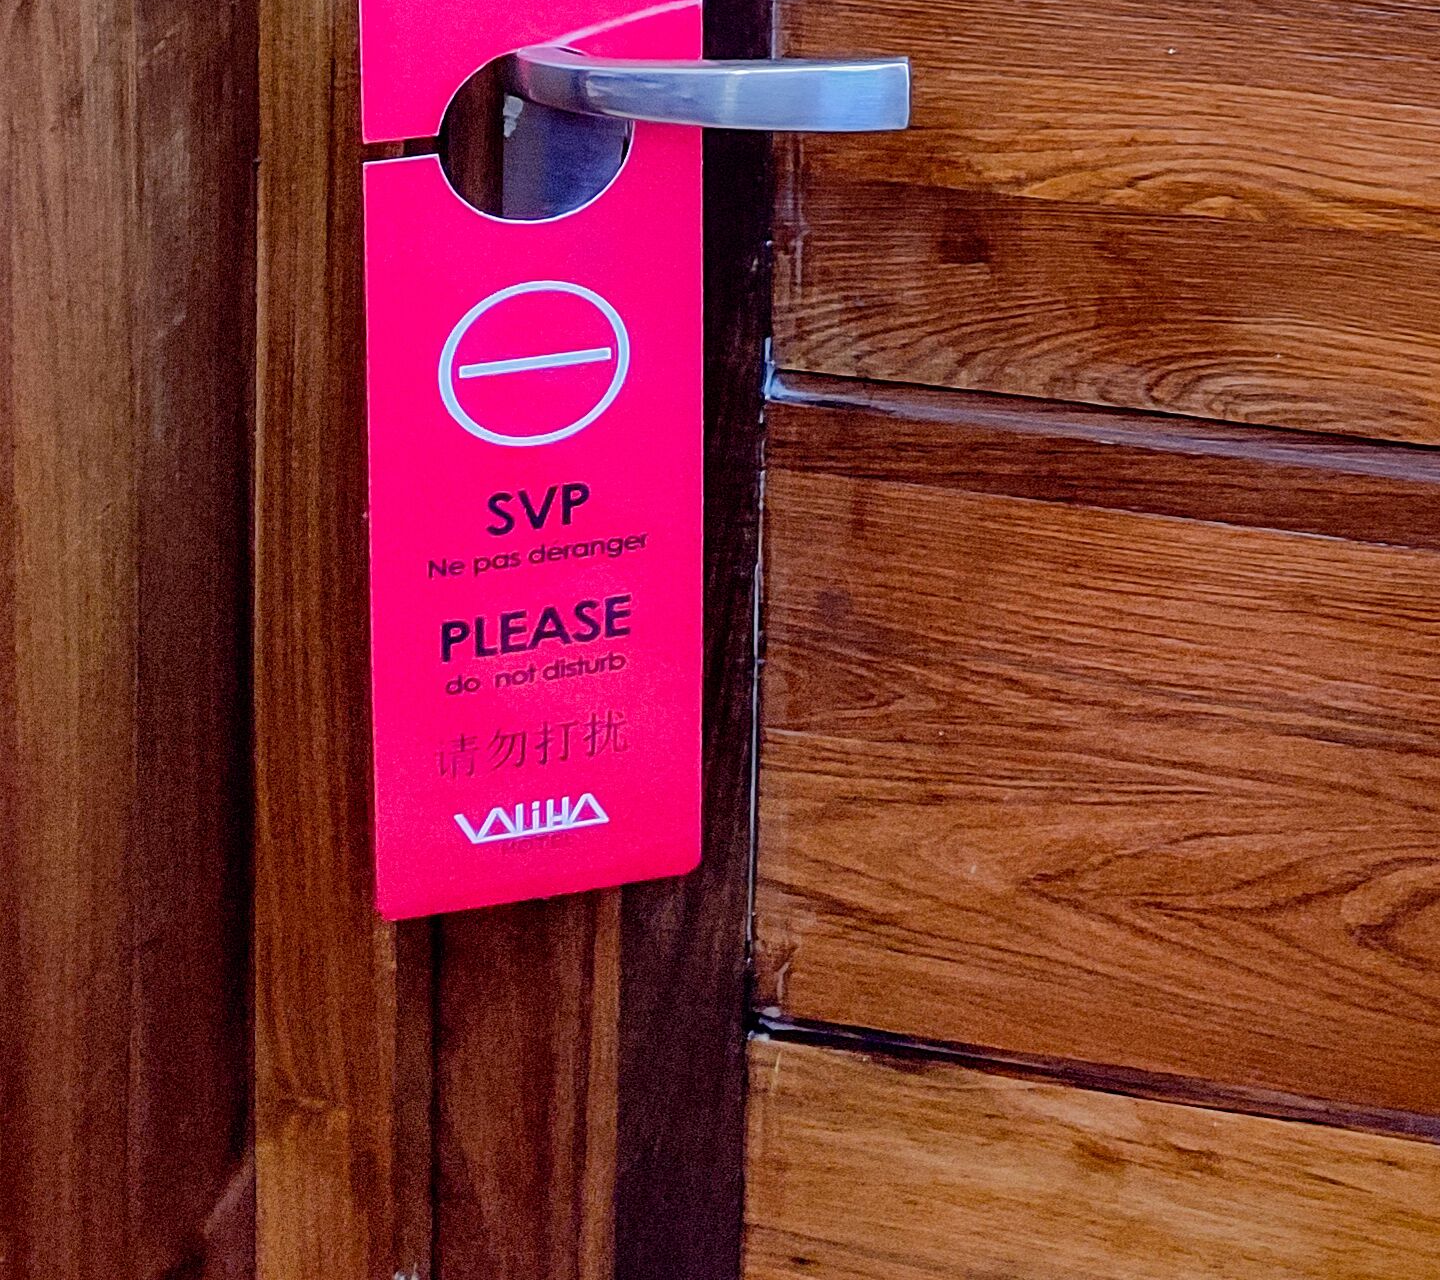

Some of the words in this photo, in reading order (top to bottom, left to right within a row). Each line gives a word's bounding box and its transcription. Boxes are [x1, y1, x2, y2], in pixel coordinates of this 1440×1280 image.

[486, 482, 590, 537] SVP
[427, 556, 465, 580] Ne
[473, 549, 521, 577] pas
[440, 594, 632, 663] PLEASE
[445, 673, 481, 696] do
[495, 667, 536, 689] not
[542, 650, 627, 681] disturb
[435, 709, 629, 779] 请勿打扰
